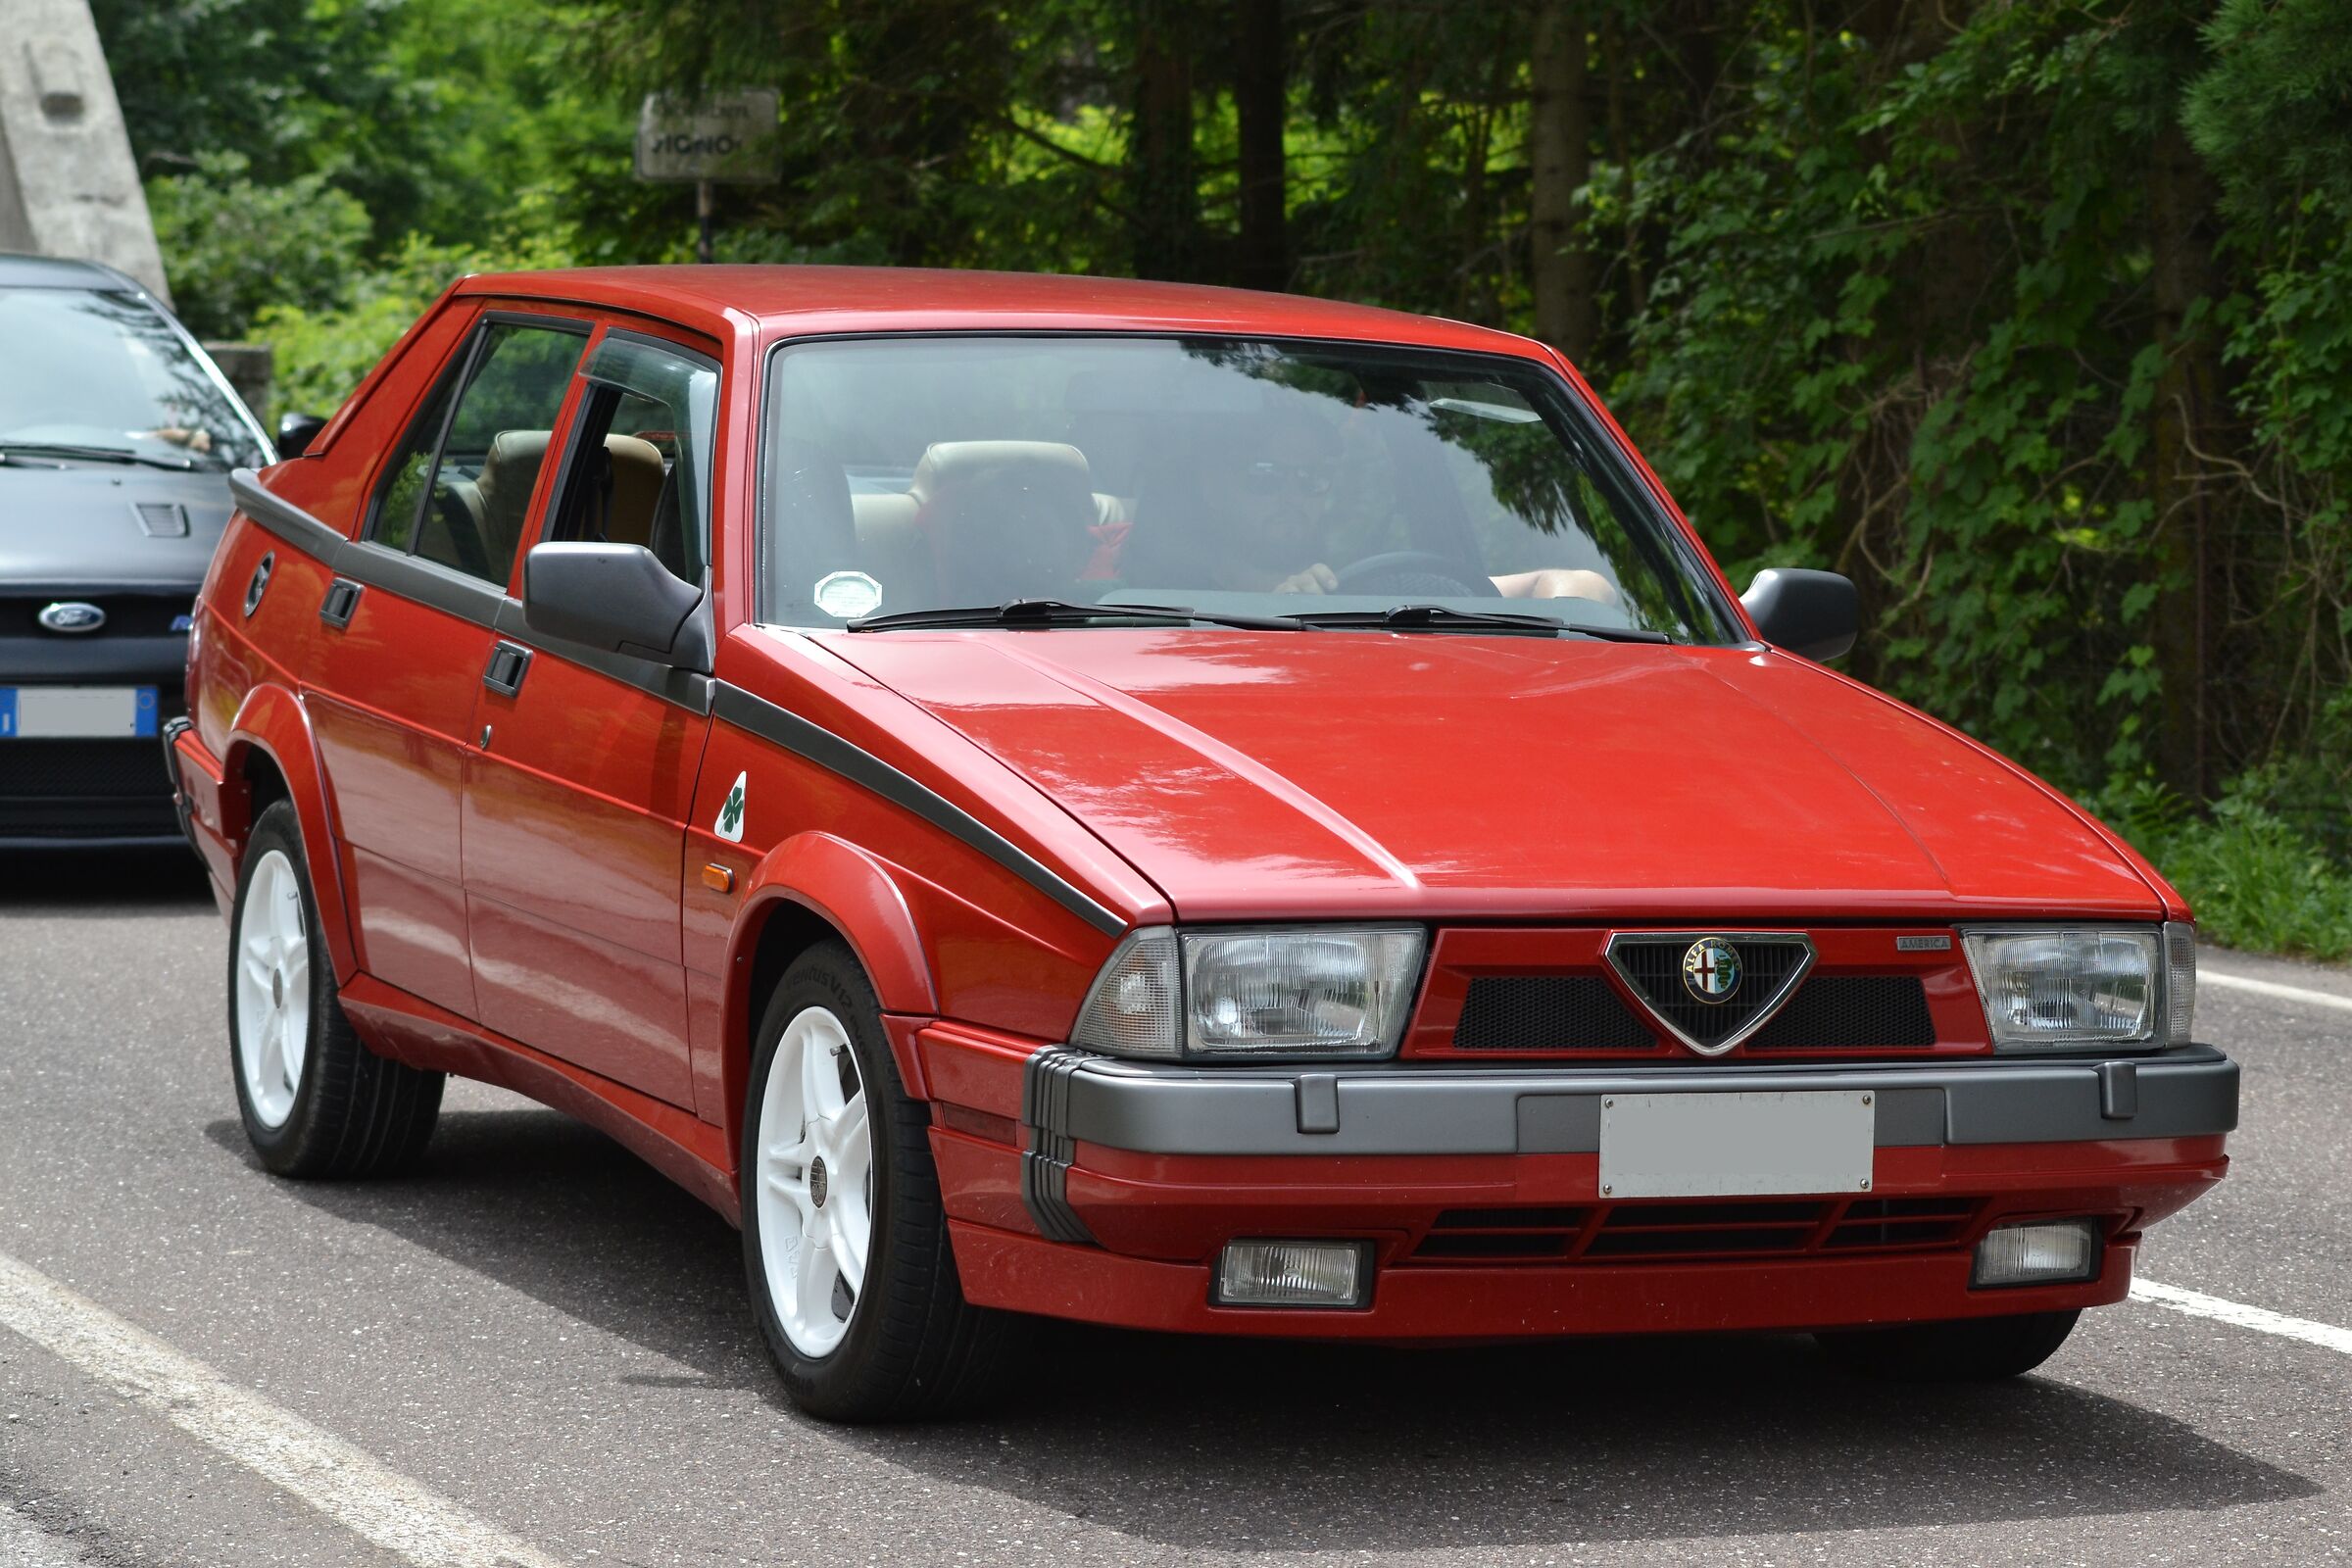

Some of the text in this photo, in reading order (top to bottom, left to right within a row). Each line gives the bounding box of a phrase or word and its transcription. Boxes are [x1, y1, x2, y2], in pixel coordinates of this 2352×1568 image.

[1686, 940, 1741, 973] ALFA ROMEO
[1900, 938, 1949, 950] AMERICA
[831, 975, 852, 1008] V12
